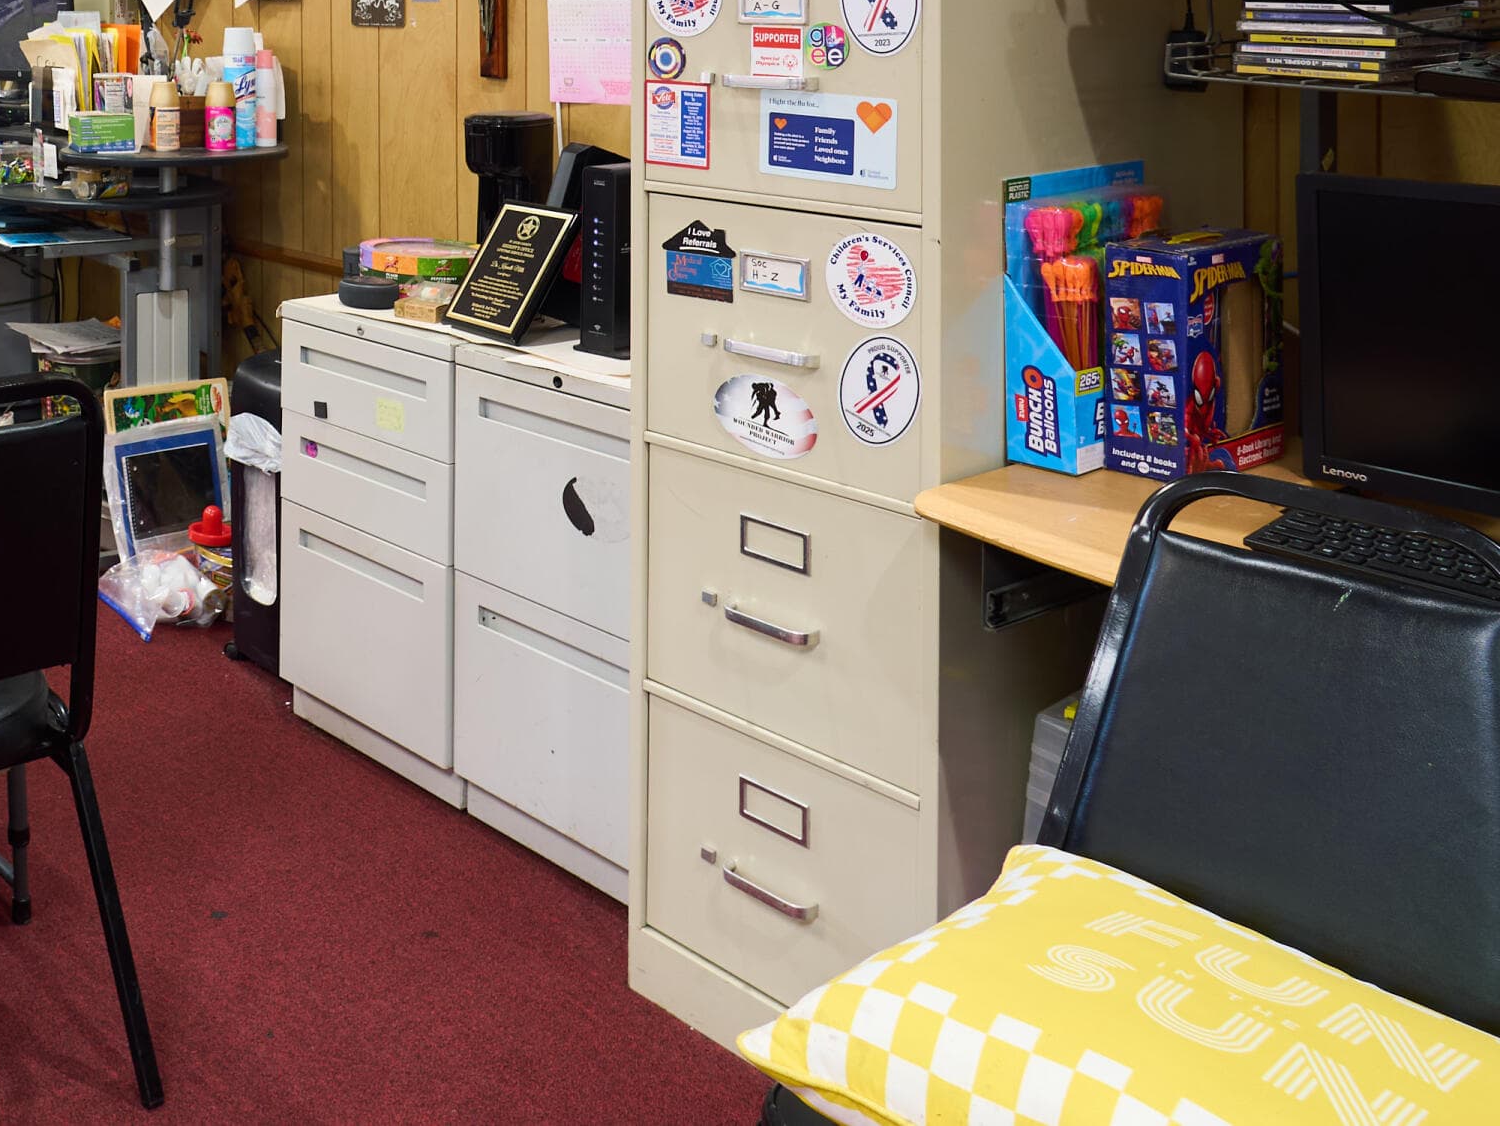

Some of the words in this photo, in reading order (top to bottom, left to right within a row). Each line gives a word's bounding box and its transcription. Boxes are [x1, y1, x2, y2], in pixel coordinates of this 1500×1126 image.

[657, 0, 667, 16] My
[666, 12, 697, 28] Family
[754, 32, 800, 44] SUPPORTER
[874, 38, 891, 47] 2023
[814, 127, 836, 136] Family
[814, 136, 838, 145] Friends
[814, 146, 833, 154] Loved
[814, 155, 846, 165] Neighbors
[1008, 191, 1029, 200] PLASTIC
[692, 228, 711, 237] Love
[682, 237, 717, 249] Referrals
[830, 234, 869, 265] Children's
[871, 235, 908, 268] Services
[901, 268, 913, 310] Council
[1107, 260, 1181, 280] SPIDER-MAN
[1190, 261, 1246, 304] SPIDER-MAN
[836, 284, 850, 302] My
[849, 299, 886, 319] Family
[867, 344, 885, 355] PROUD
[886, 344, 911, 375] SUPPORTER
[1079, 372, 1100, 387] 265+
[1028, 387, 1045, 453] BUNCH
[1044, 378, 1057, 453] Balloons
[733, 417, 764, 436] WOUNDED
[764, 429, 795, 446] WARRIOR
[856, 421, 875, 437] 2025
[749, 430, 777, 445] PROJECT
[1112, 447, 1145, 461] Includes
[1153, 456, 1177, 469] books
[1121, 460, 1136, 469] and
[1239, 450, 1262, 466] Electronic
[1322, 465, 1367, 482] Lenovo
[1082, 910, 1481, 1092] FUN
[1156, 961, 1195, 980] IN
[1227, 994, 1301, 1030] THE
[1027, 944, 1432, 1126] SUN
